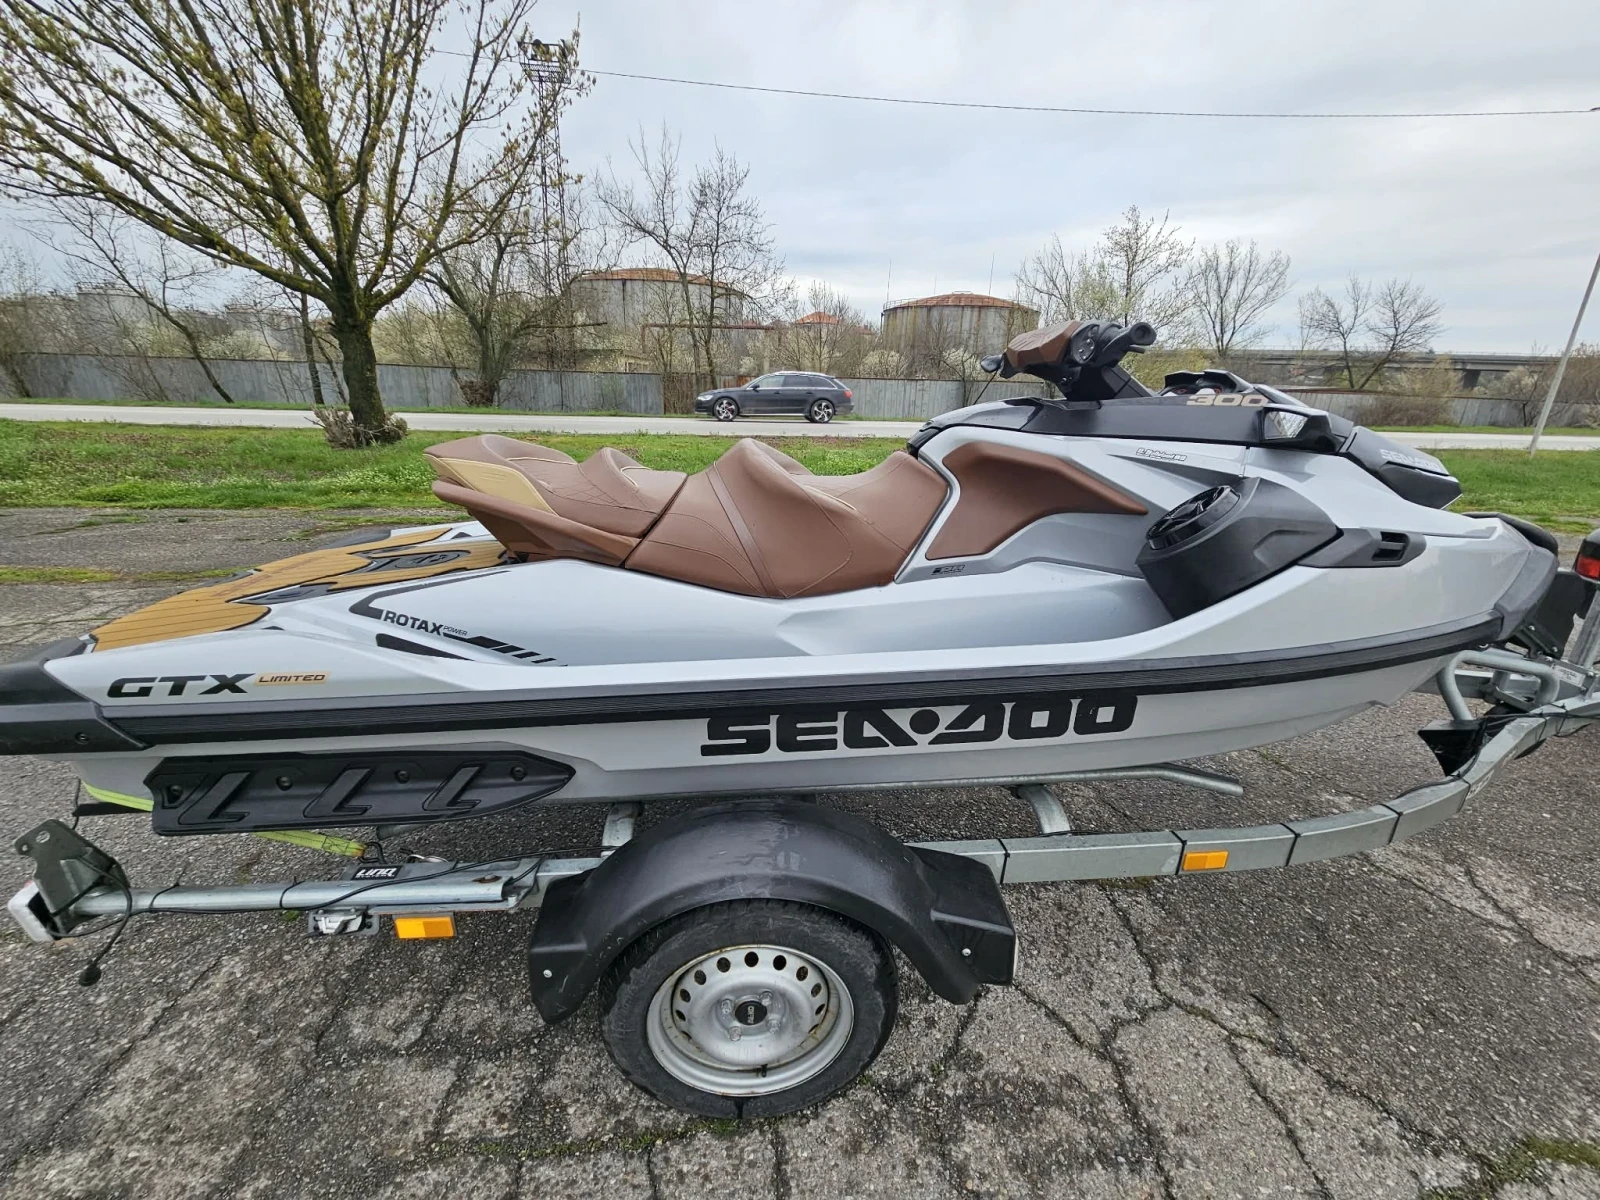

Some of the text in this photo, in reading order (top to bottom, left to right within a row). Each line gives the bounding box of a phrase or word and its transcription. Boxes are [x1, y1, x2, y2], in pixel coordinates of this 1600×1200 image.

[1186, 394, 1269, 407] 300
[383, 609, 468, 636] ROTAX POWER
[107, 673, 326, 698] GTX LIMITED
